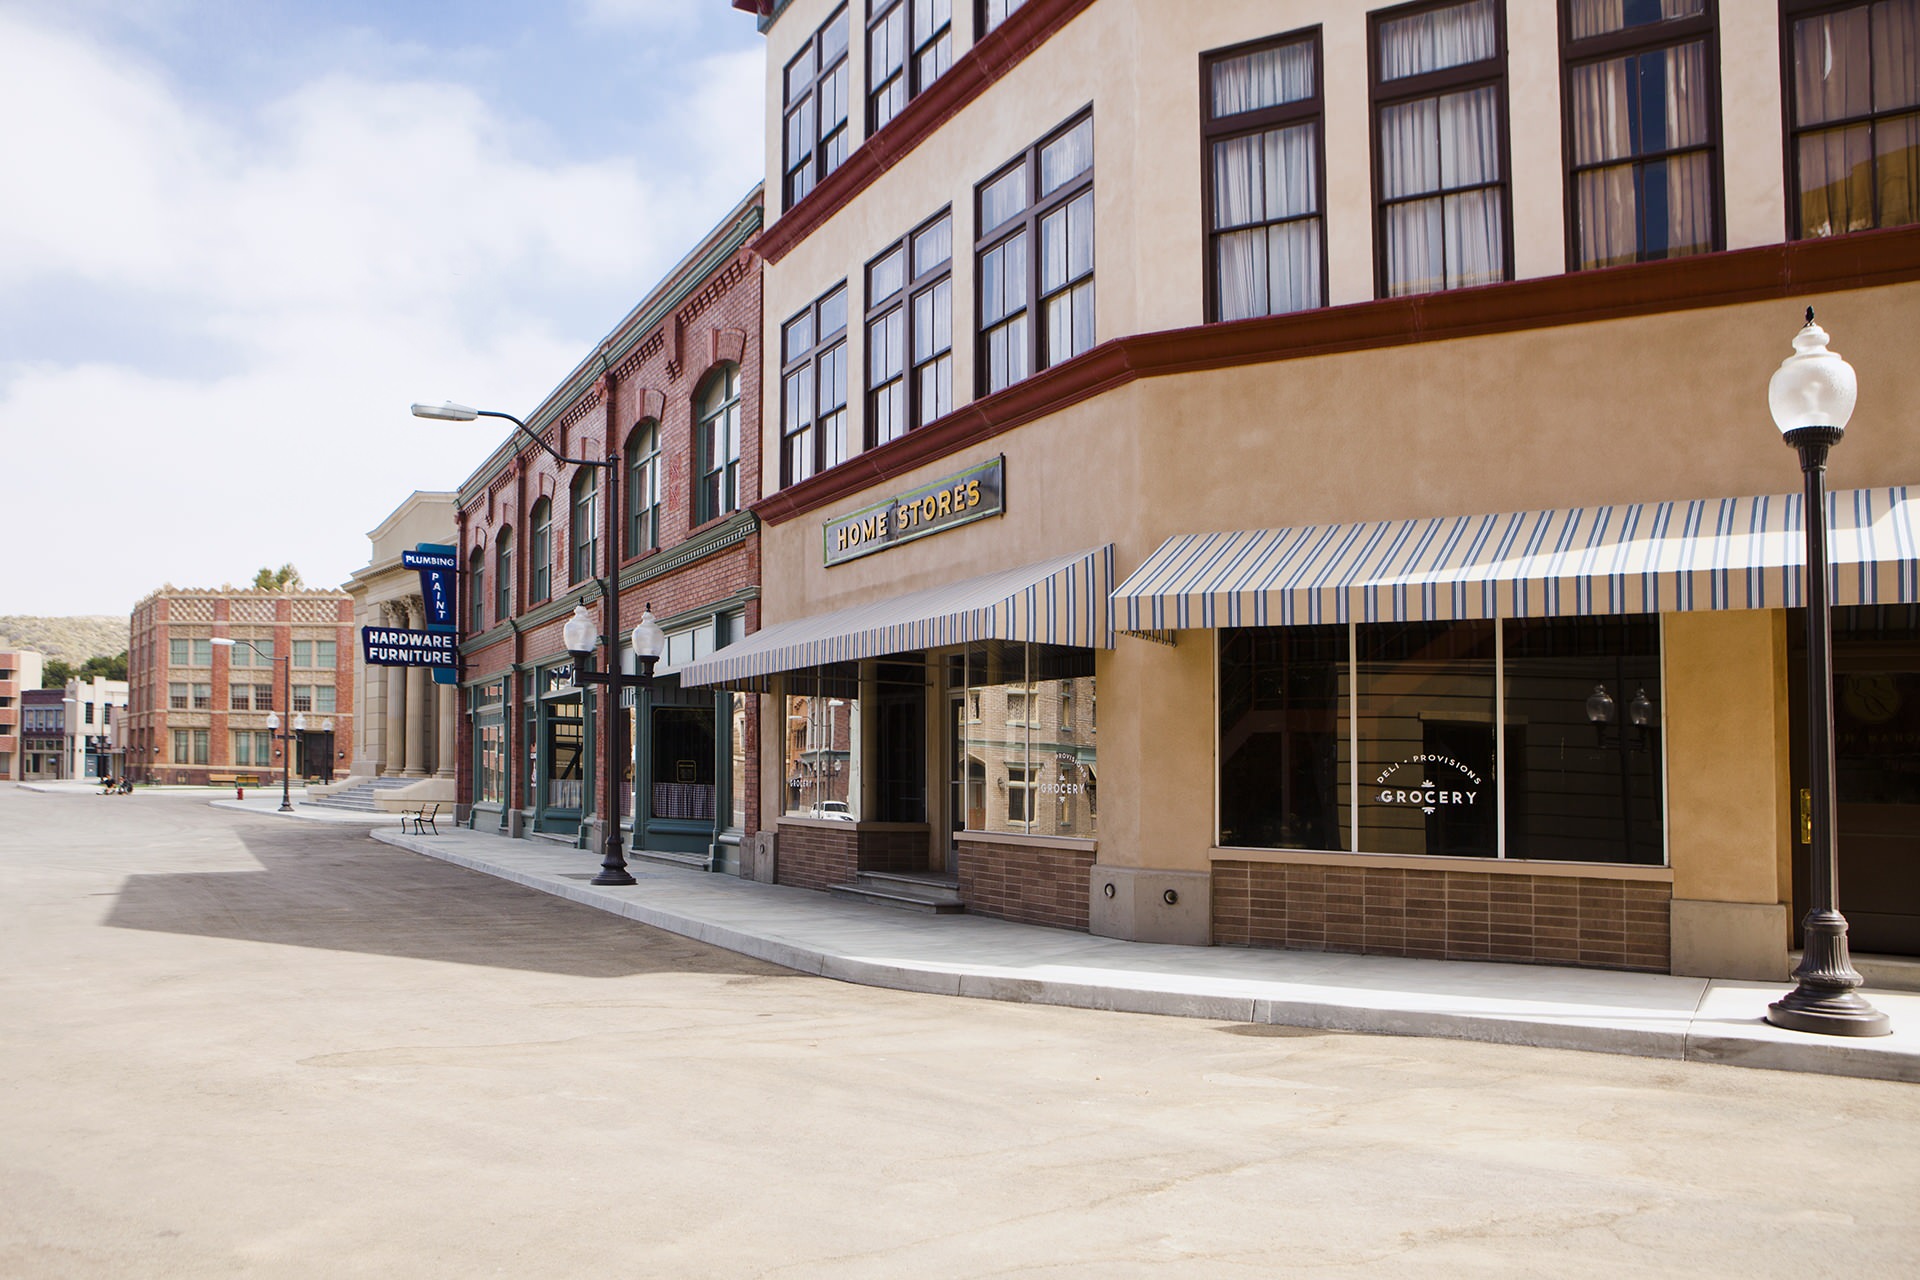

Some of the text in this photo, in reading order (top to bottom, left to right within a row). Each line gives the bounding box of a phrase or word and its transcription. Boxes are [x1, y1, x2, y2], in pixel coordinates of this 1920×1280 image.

[837, 479, 982, 551] HOME STORES
[405, 554, 455, 567] PLUMBING
[431, 572, 447, 619] PAINT
[369, 631, 453, 648] HARDWARE
[369, 647, 453, 664] FURNITURE
[1376, 754, 1482, 785] DELI PROVISIONS
[1041, 783, 1085, 795] GROCERY
[1380, 790, 1477, 805] GROCERY
